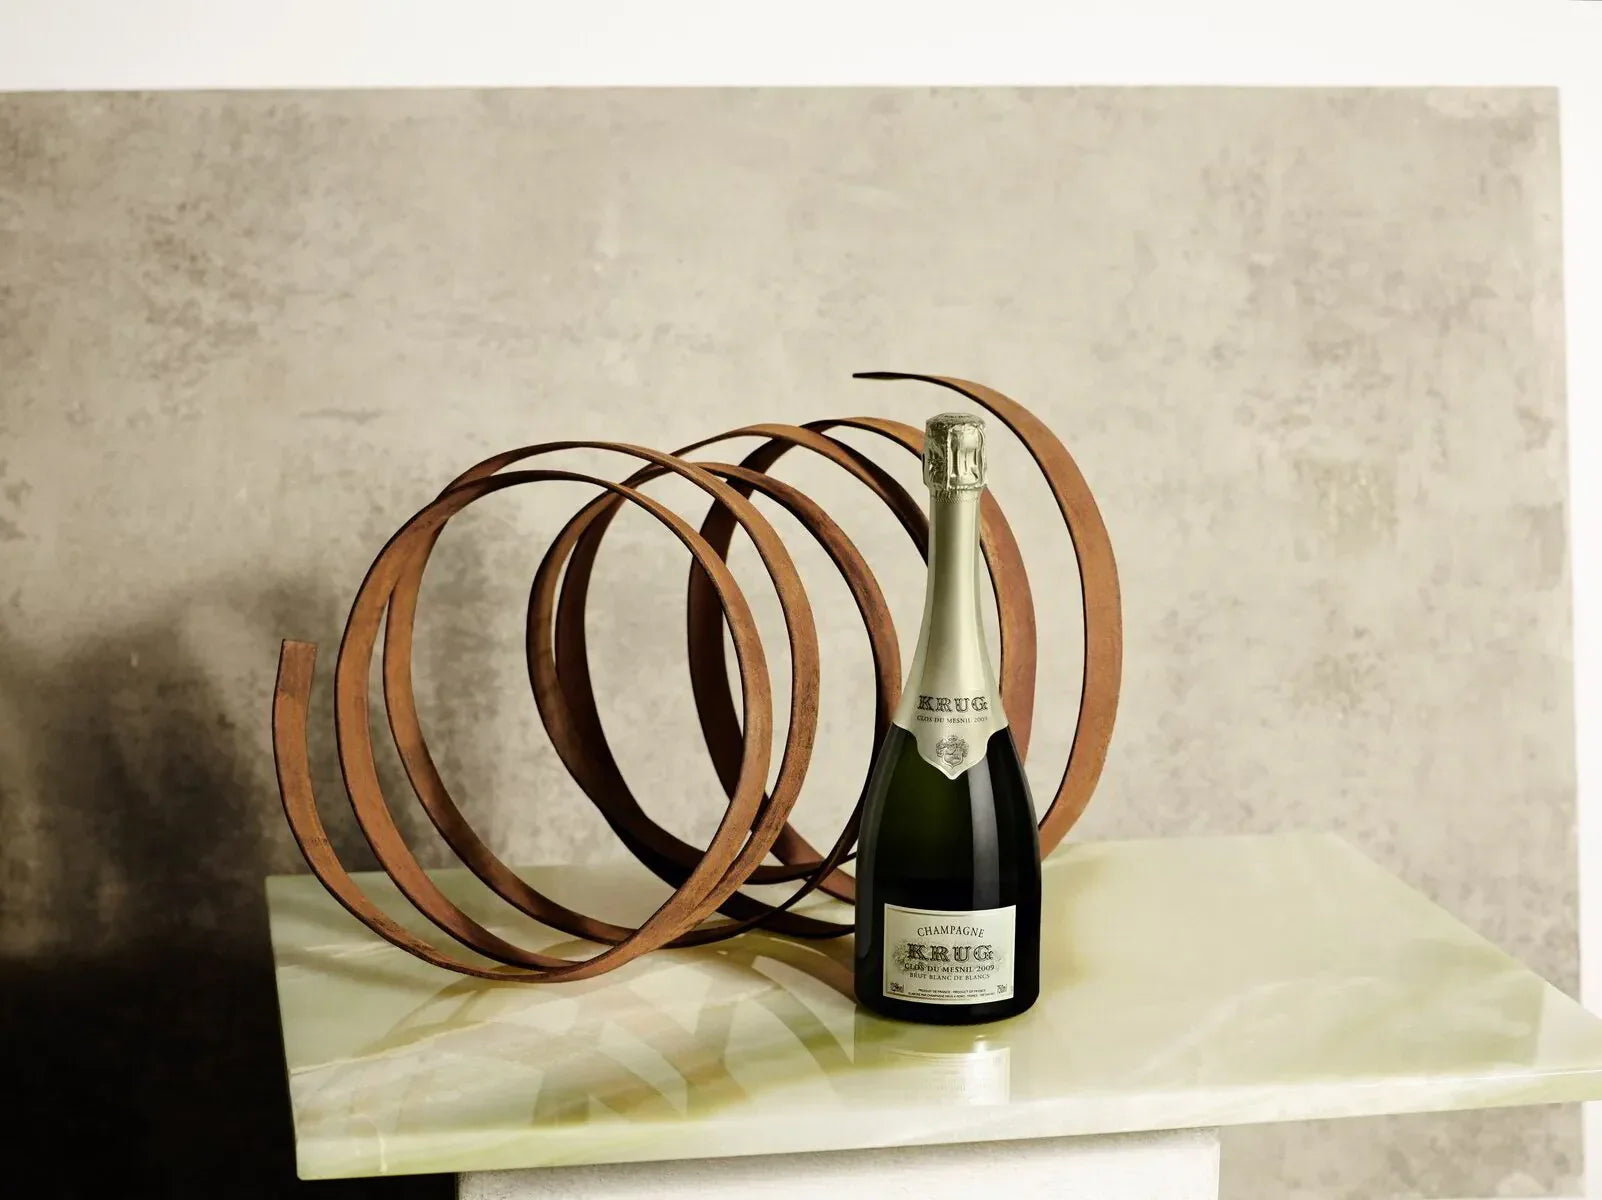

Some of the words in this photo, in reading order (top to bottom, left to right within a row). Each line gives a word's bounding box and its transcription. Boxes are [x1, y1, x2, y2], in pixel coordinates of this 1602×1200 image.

[917, 695, 988, 713] KRUG
[917, 925, 985, 938] CHAMPAGNE
[907, 943, 994, 962] KRUG
[904, 962, 925, 972] CLOS
[927, 965, 940, 973] DU
[942, 965, 973, 974] MESNIL
[976, 964, 995, 973] 2009
[909, 972, 927, 980] BRUT
[965, 973, 990, 981] BLANCS
